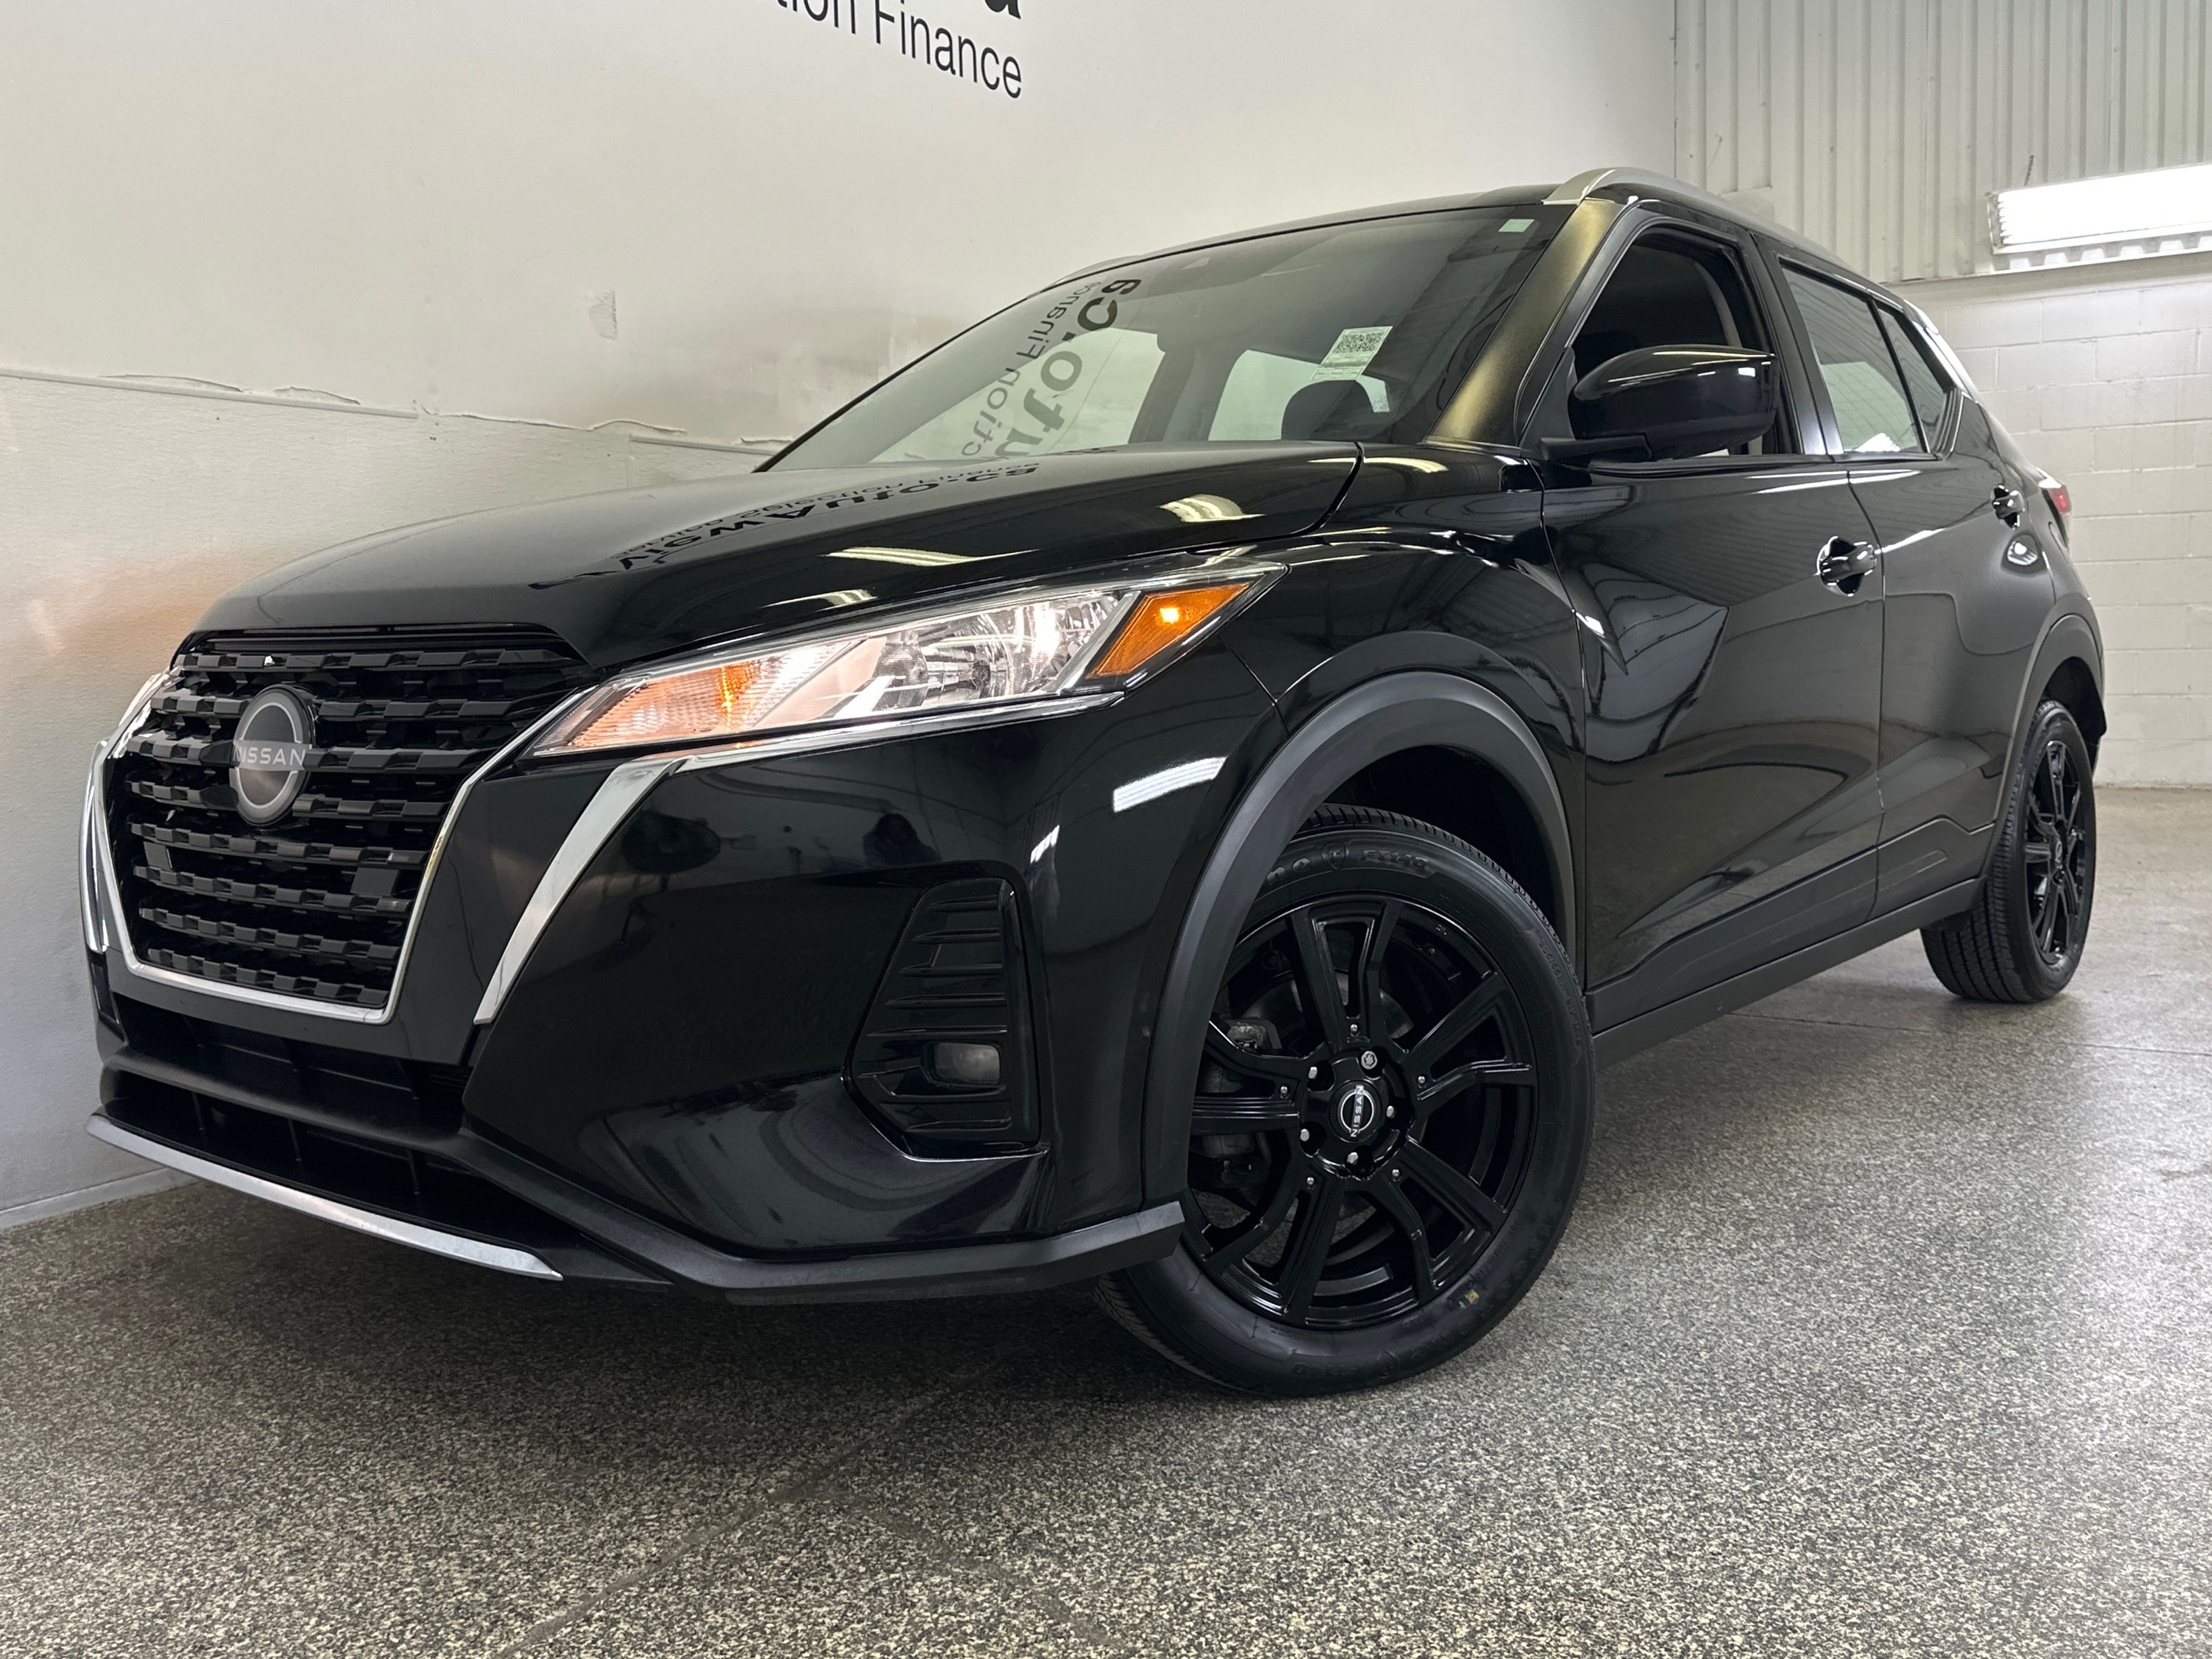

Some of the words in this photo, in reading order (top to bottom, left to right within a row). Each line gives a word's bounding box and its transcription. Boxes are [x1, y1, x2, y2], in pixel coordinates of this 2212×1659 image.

[875, 0, 1022, 99] Finance
[233, 745, 306, 767] NISSAN
[1349, 1084, 1365, 1138] NISSAN
